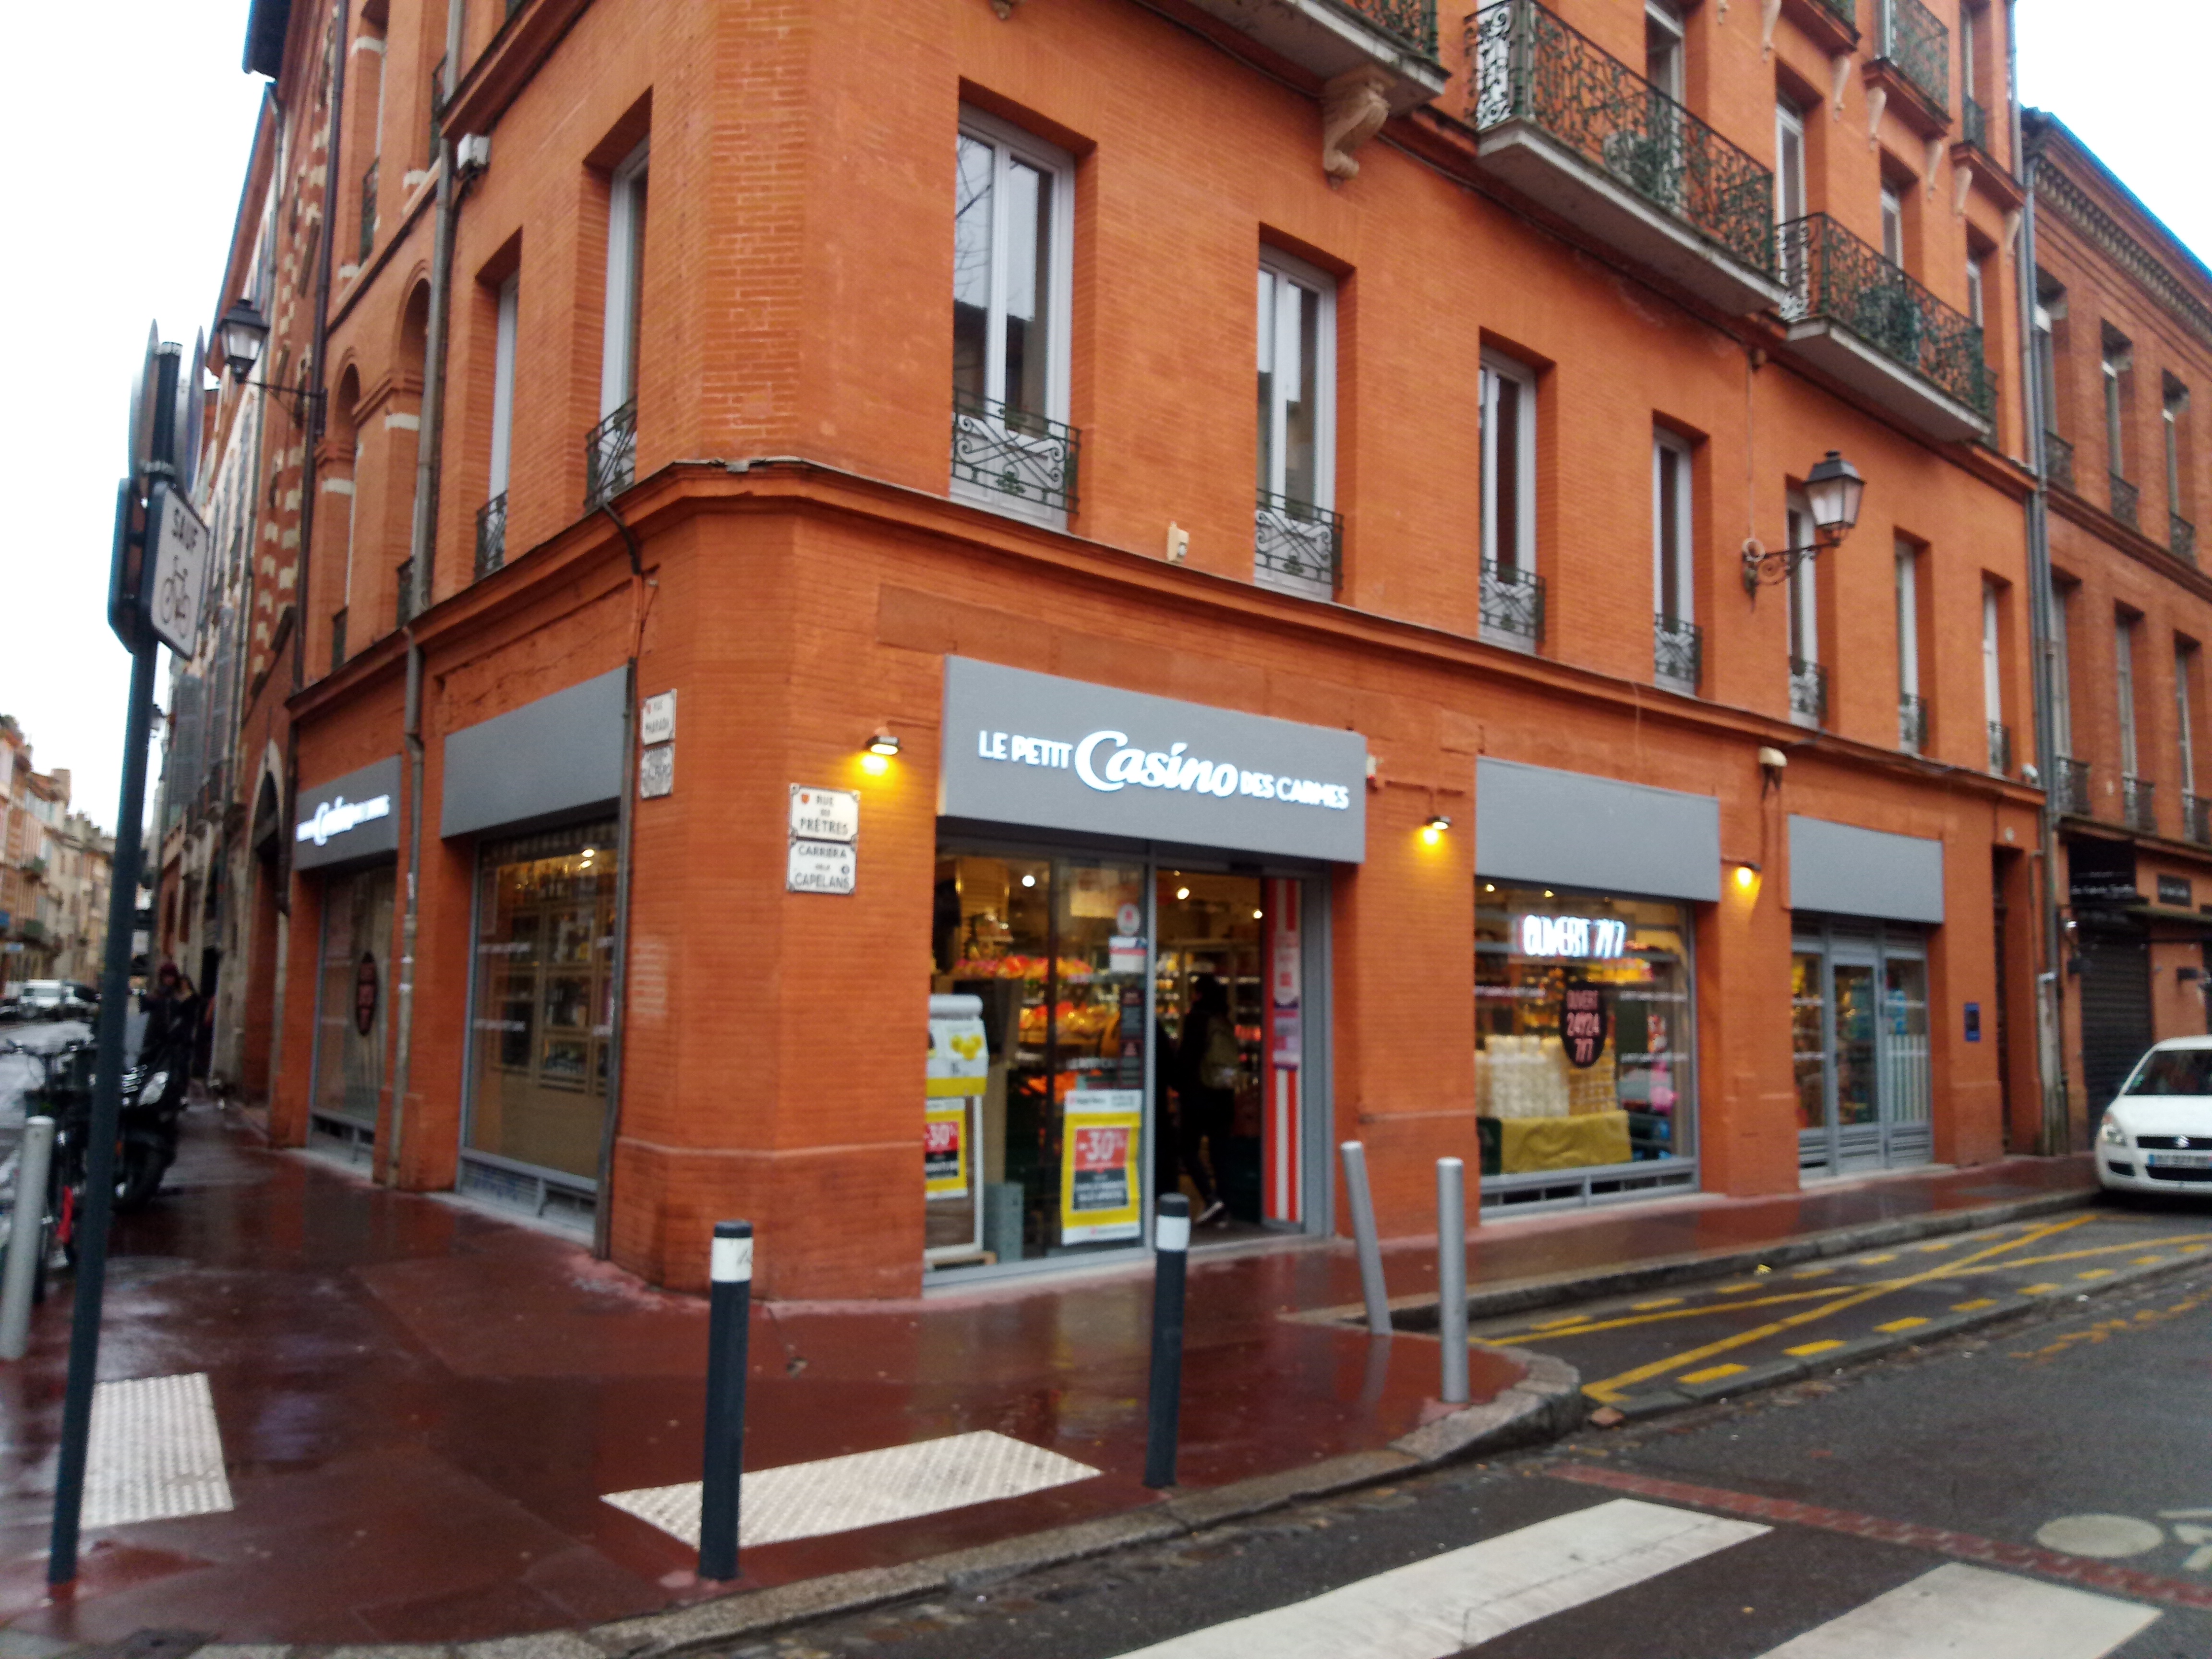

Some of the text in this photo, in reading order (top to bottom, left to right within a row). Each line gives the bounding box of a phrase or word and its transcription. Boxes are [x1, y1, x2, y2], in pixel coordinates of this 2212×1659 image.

[979, 730, 1349, 808] LE PETIT Casino DES CARMES
[1524, 914, 1590, 957] OUVERT
